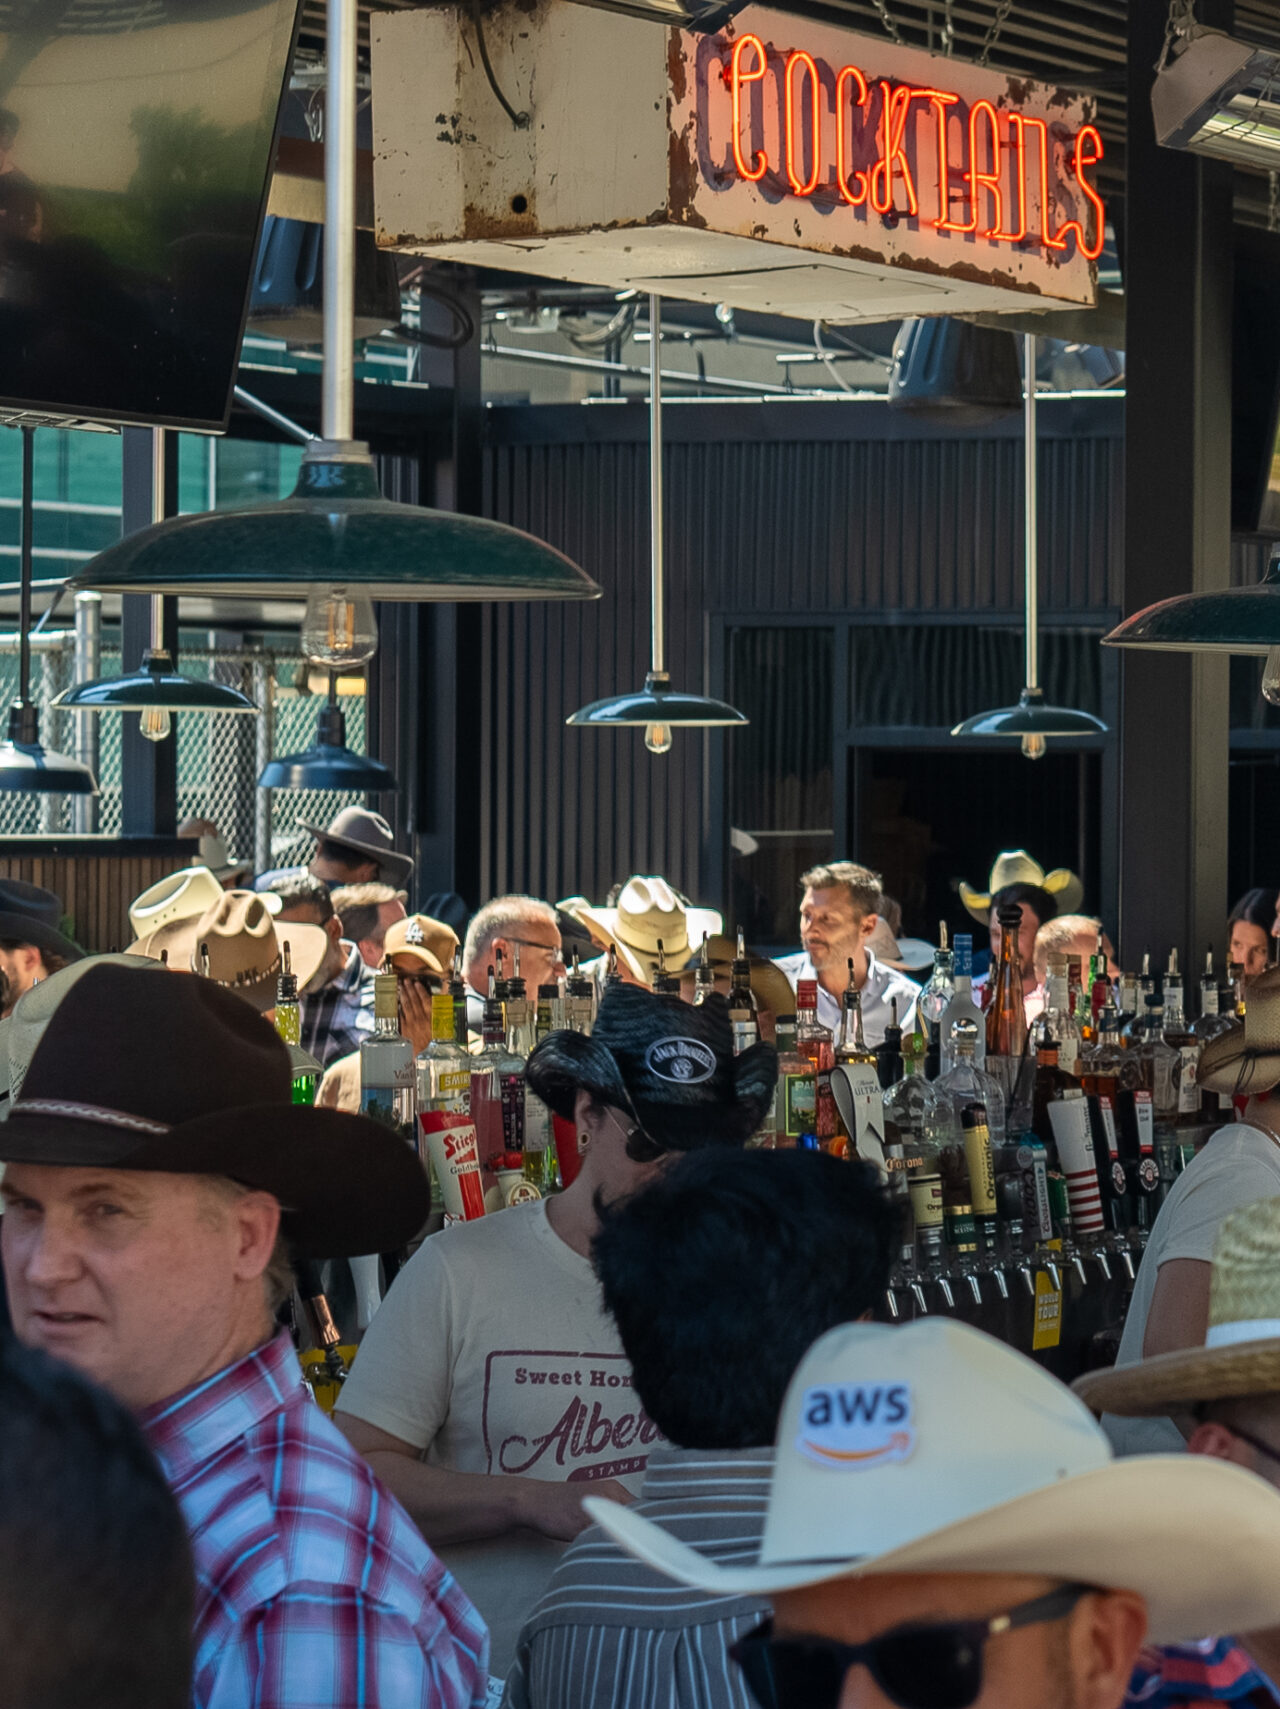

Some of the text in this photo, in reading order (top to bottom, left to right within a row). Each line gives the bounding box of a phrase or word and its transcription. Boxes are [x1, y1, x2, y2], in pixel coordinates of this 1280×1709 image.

[697, 33, 1105, 260] COCKTAILS
[405, 921, 424, 943] LA
[855, 1085, 880, 1097] ULTRA
[886, 1157, 924, 1172] Corona
[983, 1138, 996, 1200] Organic
[515, 1367, 582, 1386] Sweet
[806, 1386, 908, 1427] aws
